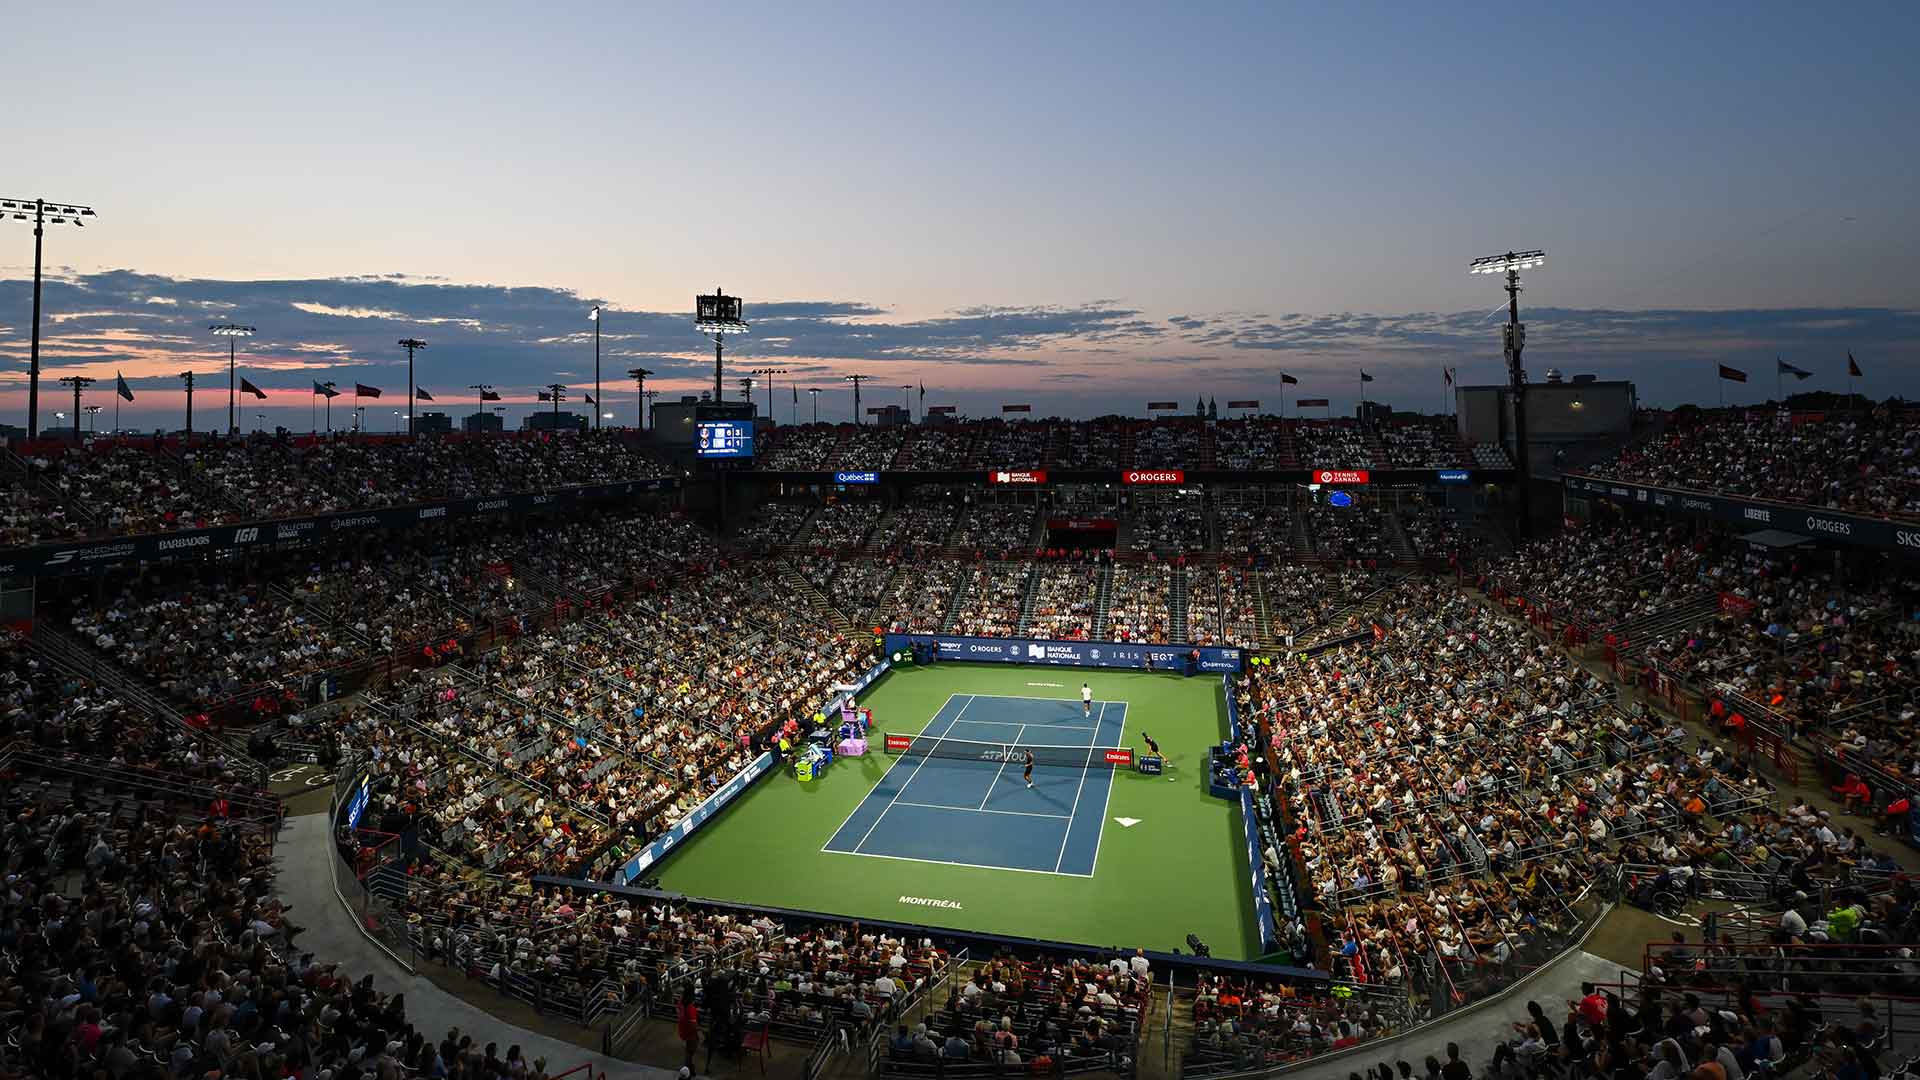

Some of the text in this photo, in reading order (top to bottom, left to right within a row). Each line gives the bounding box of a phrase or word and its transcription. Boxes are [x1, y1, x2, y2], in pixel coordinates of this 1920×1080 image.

[839, 473, 864, 482] Québec
[1140, 473, 1177, 481] ROGERS
[484, 499, 509, 510] ROGERS
[1816, 519, 1850, 535] ROGERS
[233, 528, 259, 543] IGA
[159, 536, 210, 550] BARBADOS
[79, 543, 136, 556] SKECHERS
[1047, 652, 1081, 660] NATIONALE
[1151, 653, 1174, 661] EQT
[899, 895, 963, 910] MONTRÉAL
